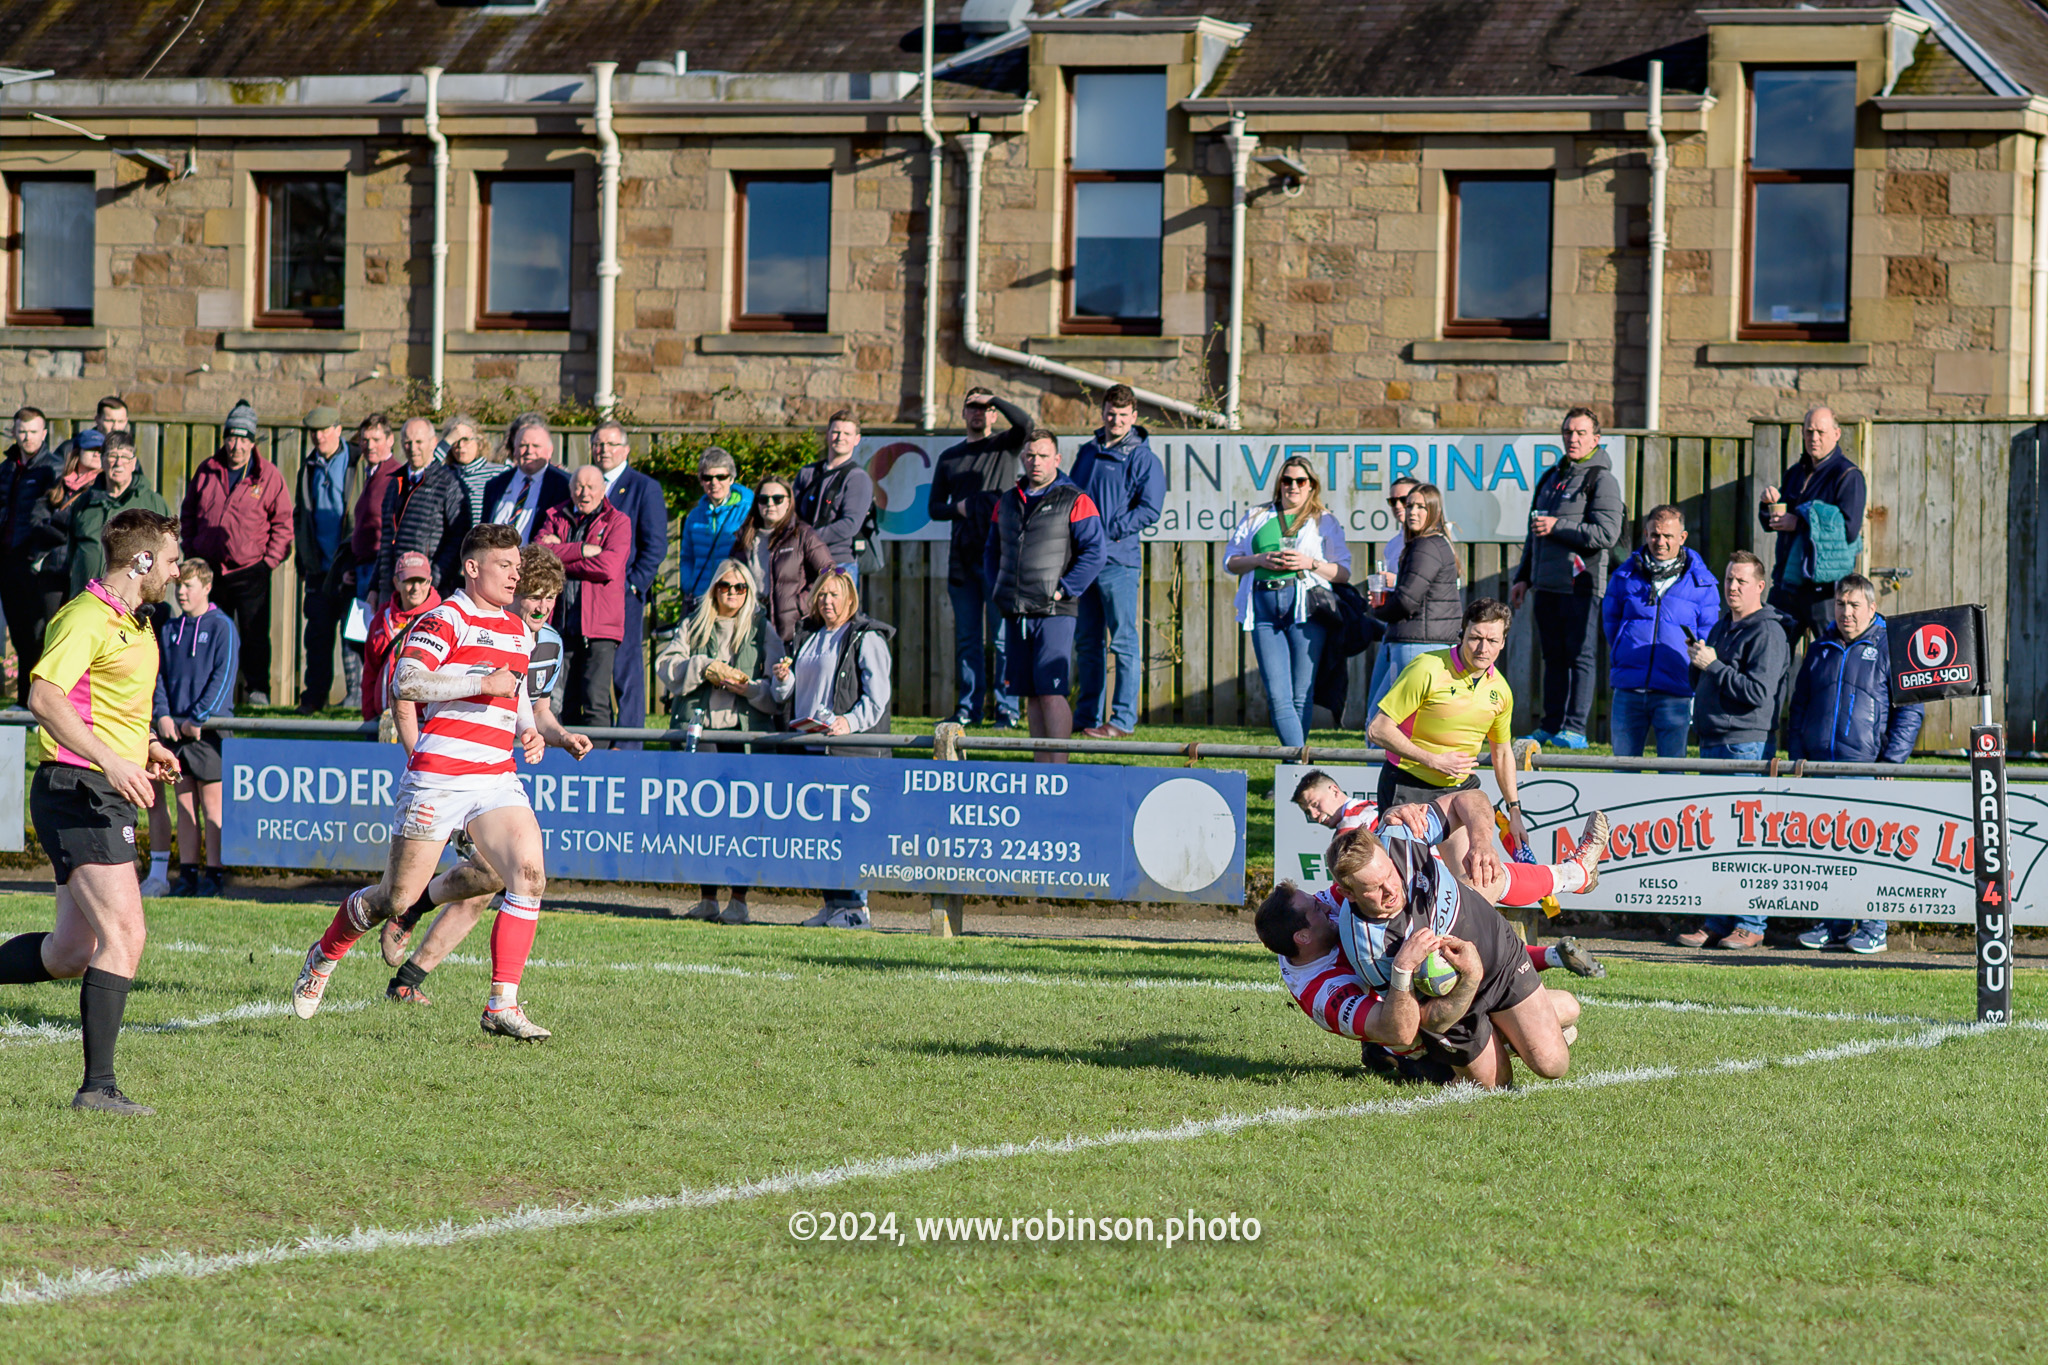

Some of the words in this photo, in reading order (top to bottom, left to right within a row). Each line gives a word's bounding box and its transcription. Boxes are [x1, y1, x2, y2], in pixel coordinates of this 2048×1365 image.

[1240, 444, 1608, 491] VTERINAR
[233, 764, 394, 807] BORDER
[641, 777, 872, 823] PRODUCTS
[903, 770, 1027, 795] JEDBURGH
[1035, 774, 1069, 796] RD
[950, 804, 1021, 827] KELSO
[257, 819, 347, 842] PRECAST
[1553, 804, 1715, 865] Acroft
[1732, 800, 1920, 862] Tractors
[560, 829, 634, 853] STONE
[641, 834, 842, 861] MANUFACTURERS
[888, 834, 919, 857] Tel
[926, 836, 993, 860] 01573
[1000, 840, 1081, 863] 224393
[860, 864, 1110, 888] SALES@BORDERCONCRETE.CO.UK
[1712, 862, 1858, 877] BERWICK-UPON-TWEED
[1639, 878, 1678, 890] KELSO
[1740, 878, 1779, 890] 01289
[1783, 879, 1828, 892] 331904
[1877, 886, 1947, 899] MACMERRY
[1615, 893, 1653, 905] 01573
[1657, 894, 1702, 907] 225213
[1748, 898, 1819, 911] SWARLAND
[1867, 901, 1905, 914] 01875
[1909, 902, 1956, 915] 617323
